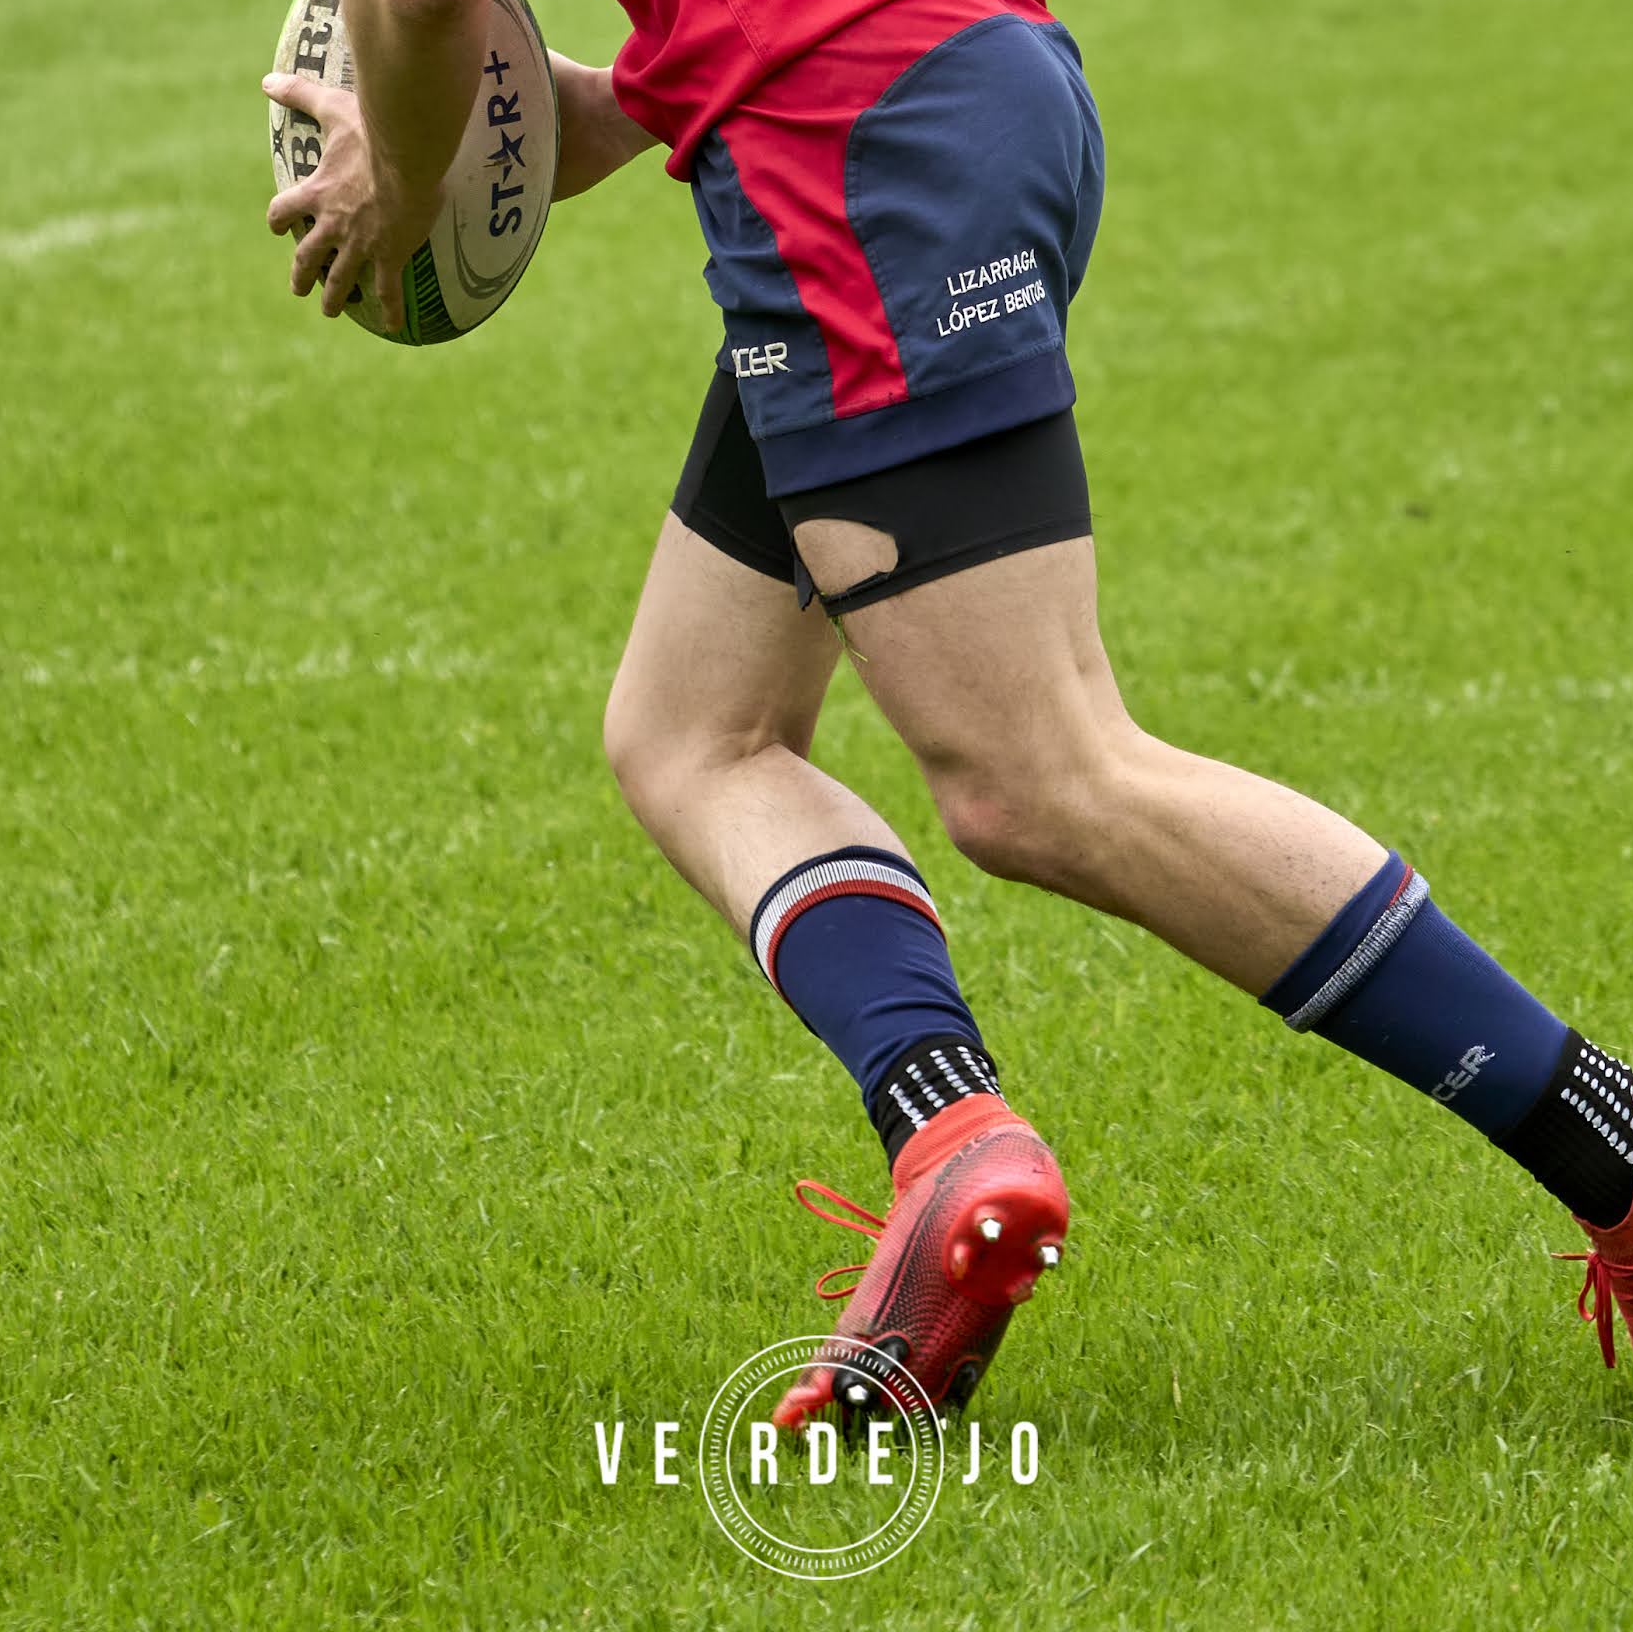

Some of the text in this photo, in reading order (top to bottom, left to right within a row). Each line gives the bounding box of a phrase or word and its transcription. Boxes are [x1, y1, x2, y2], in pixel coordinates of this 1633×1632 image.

[946, 248, 1037, 296] LIZARRAGA
[936, 279, 1046, 337] LÓPEZ BENTOS
